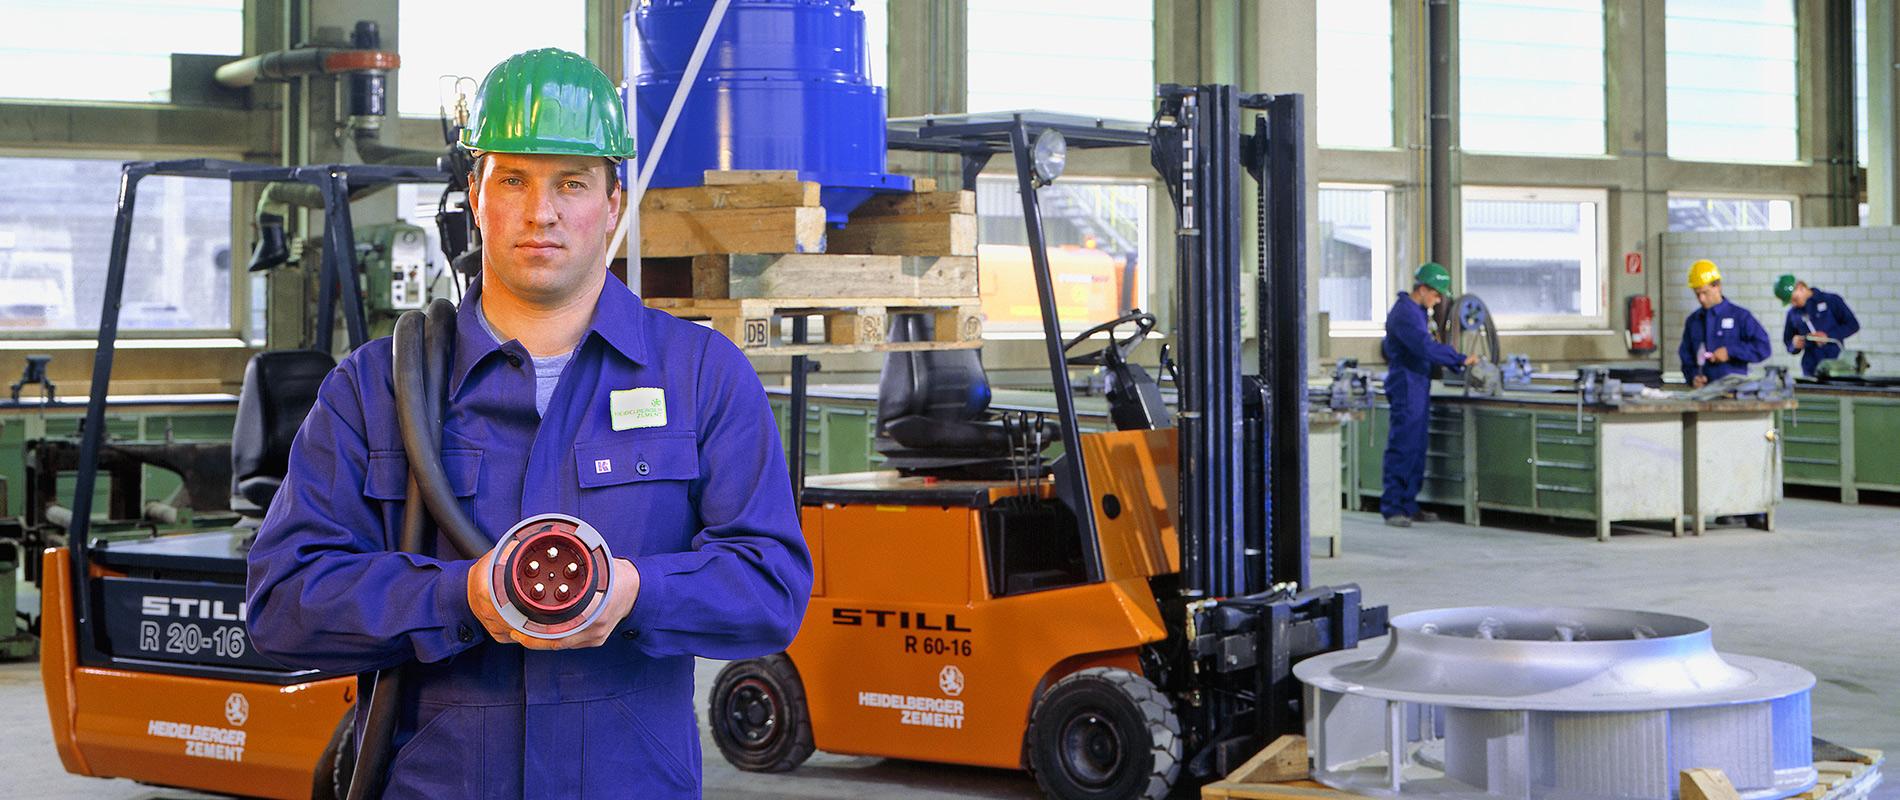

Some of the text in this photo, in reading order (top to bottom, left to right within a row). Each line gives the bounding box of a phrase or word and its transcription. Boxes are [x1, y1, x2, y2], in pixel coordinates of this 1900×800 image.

[1182, 127, 1193, 229] STILL
[748, 323, 765, 343] DB
[141, 595, 247, 622] STIL
[832, 608, 972, 633] STILL
[139, 620, 246, 659] R 20-16
[905, 635, 972, 657] R 60-16
[858, 691, 964, 714] HEIDELBERGER
[900, 710, 965, 730] ZEMENT
[147, 719, 247, 746] HEIDELBERGER
[185, 740, 245, 763] ZEMENT
